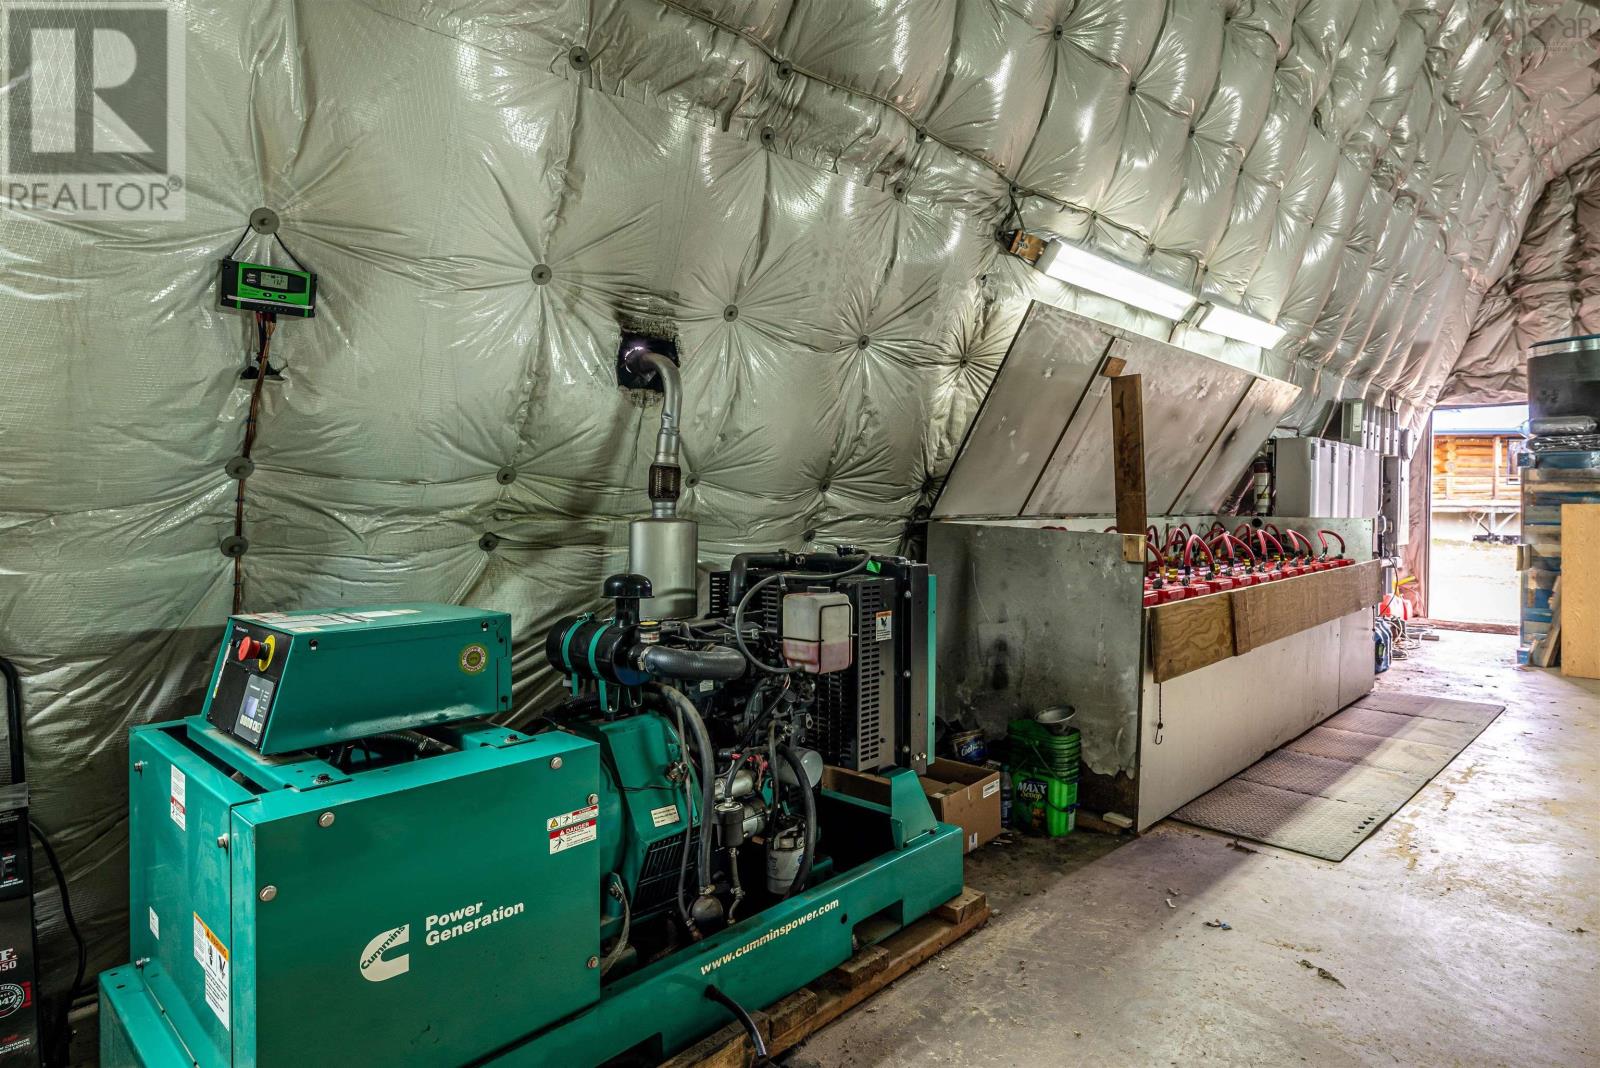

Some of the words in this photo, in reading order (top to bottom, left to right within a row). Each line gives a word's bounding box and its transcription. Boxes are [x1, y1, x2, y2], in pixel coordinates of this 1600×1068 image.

[565, 822, 590, 834] DANGER
[425, 901, 483, 931] Power
[425, 902, 524, 946] Generation
[700, 898, 839, 976] www.cumminspower.com
[360, 926, 406, 971] Cummins
